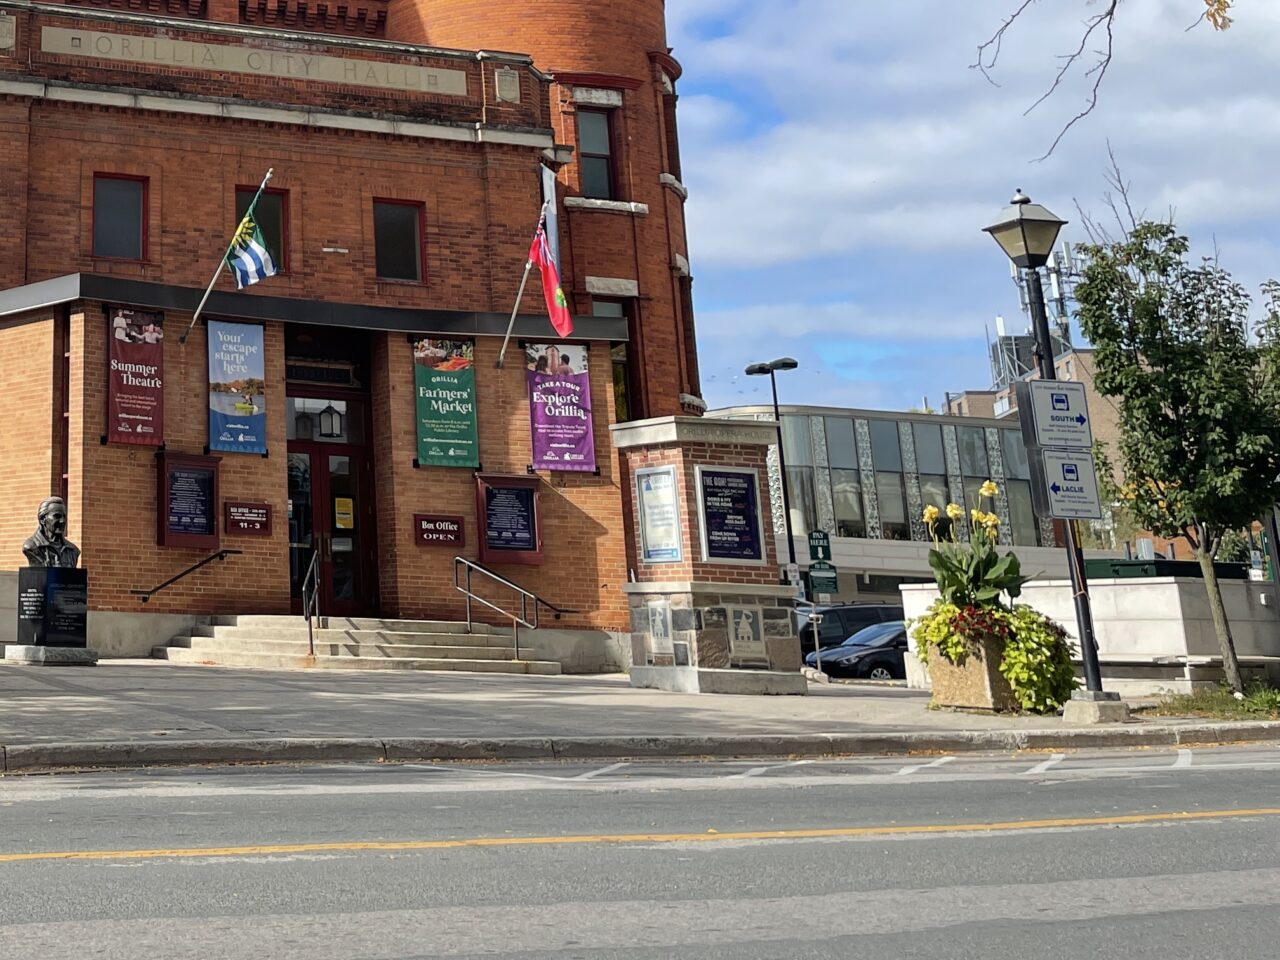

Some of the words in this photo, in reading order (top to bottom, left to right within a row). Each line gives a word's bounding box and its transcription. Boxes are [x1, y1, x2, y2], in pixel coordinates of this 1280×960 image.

[95, 36, 216, 66] ORILLIA
[246, 52, 313, 76] CITY
[343, 62, 416, 86] HALL
[217, 330, 244, 342] Your
[222, 343, 258, 356] escape
[215, 352, 246, 364] starts
[110, 359, 158, 376] Summer
[224, 362, 248, 374] here
[120, 372, 162, 388] Theatre
[431, 376, 458, 384] ORILLIA
[537, 381, 554, 391] TAKE
[562, 382, 580, 392] TOUR
[420, 386, 470, 401] Farmers'
[532, 392, 579, 406] Explore
[430, 400, 472, 414] Market
[545, 406, 587, 420] Orillia
[1062, 484, 1084, 493] LACLIE
[422, 520, 434, 530] Box
[436, 521, 458, 531] Office
